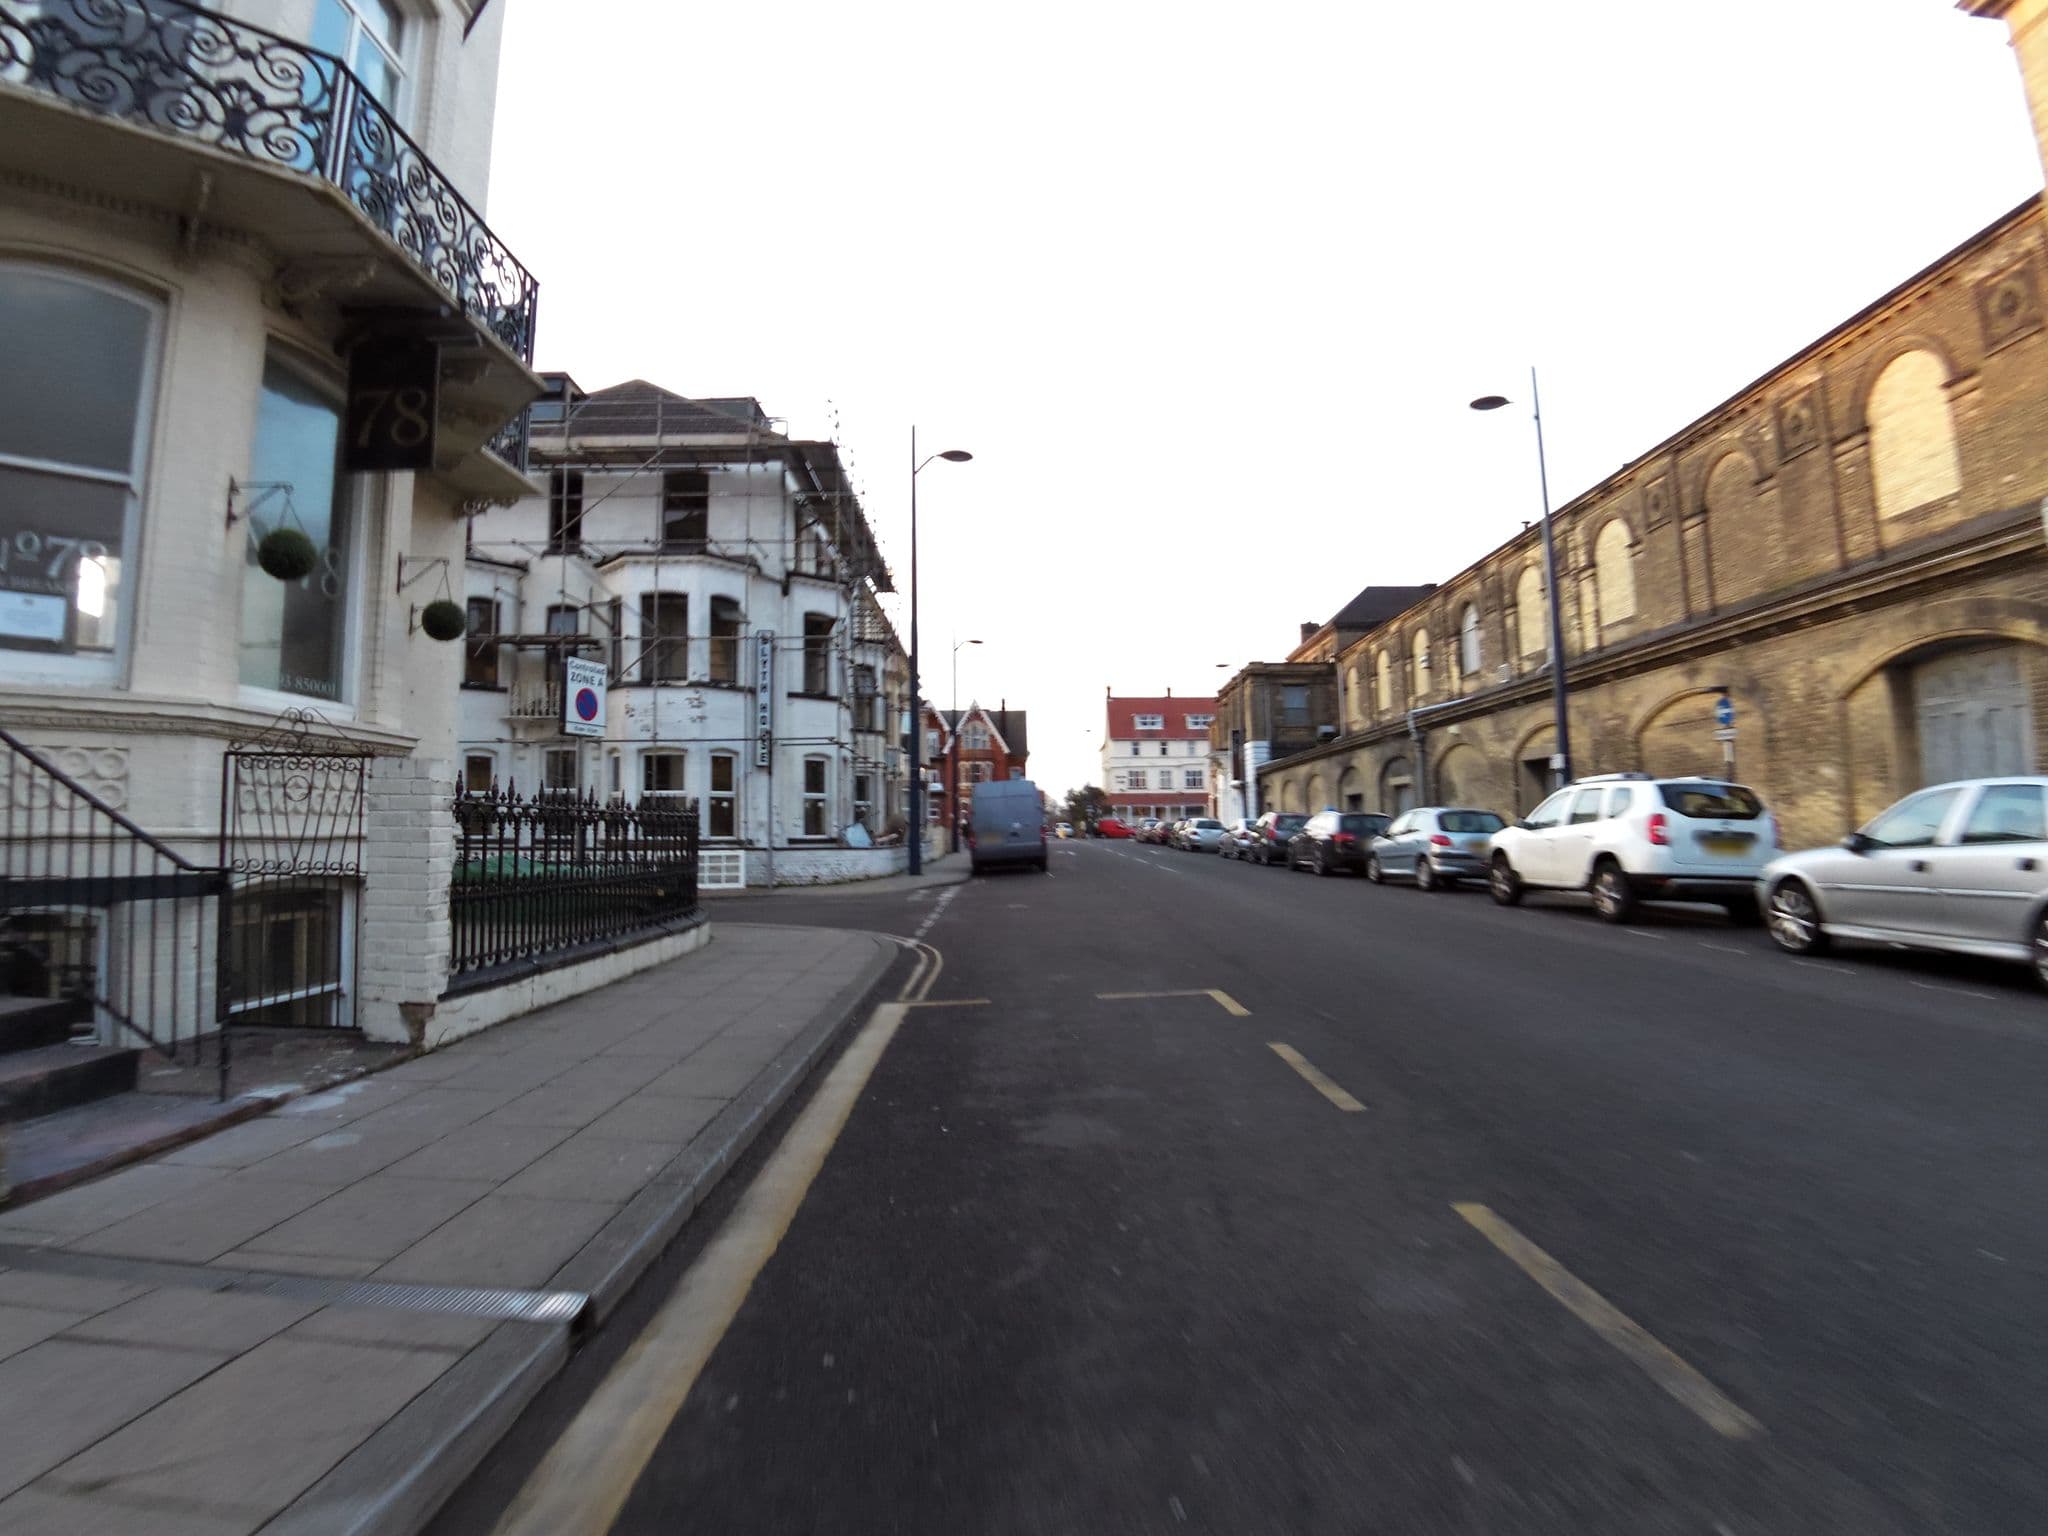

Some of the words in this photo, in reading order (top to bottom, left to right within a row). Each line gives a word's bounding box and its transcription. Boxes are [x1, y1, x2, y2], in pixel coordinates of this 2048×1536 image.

[355, 386, 430, 449] 78
[570, 671, 596, 686] ZONE
[597, 678, 604, 688] A
